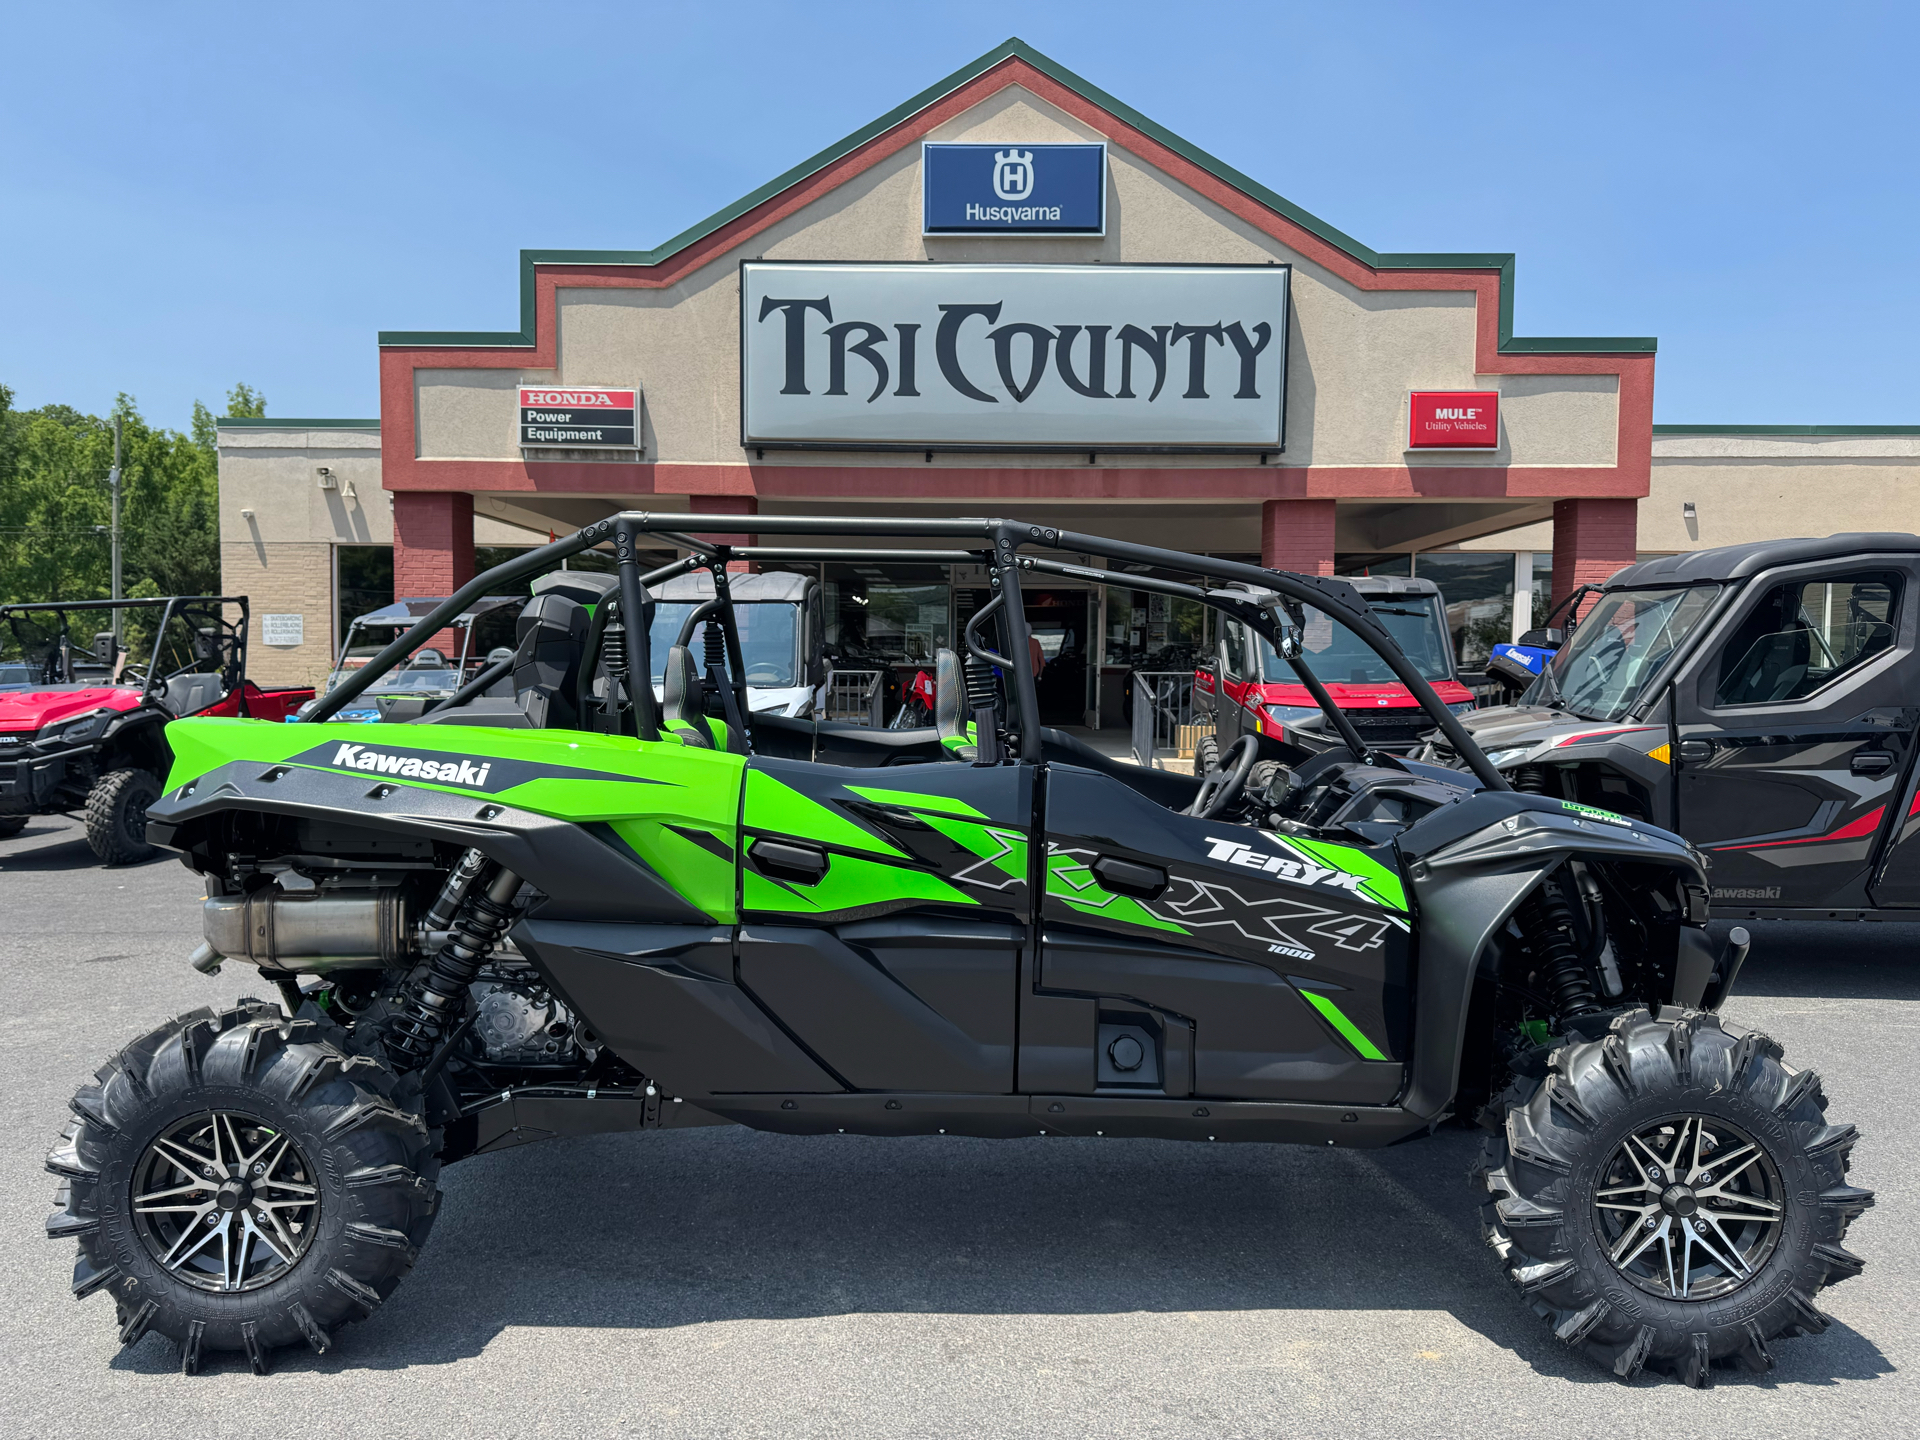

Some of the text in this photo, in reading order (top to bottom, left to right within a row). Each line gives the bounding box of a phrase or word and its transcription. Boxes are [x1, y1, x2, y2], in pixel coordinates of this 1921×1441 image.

[966, 203, 1062, 224] Husqvarna
[527, 392, 614, 406] HONDA
[527, 410, 572, 423] Power
[527, 427, 603, 442] Equipment
[1425, 421, 1487, 432] Utility Vehicles
[1505, 647, 1534, 666] Kawasaki
[1359, 718, 1408, 726] POLARIS
[332, 743, 492, 787] Kawasaki
[1204, 836, 1373, 891] TERYX
[1267, 944, 1316, 961] 1000
